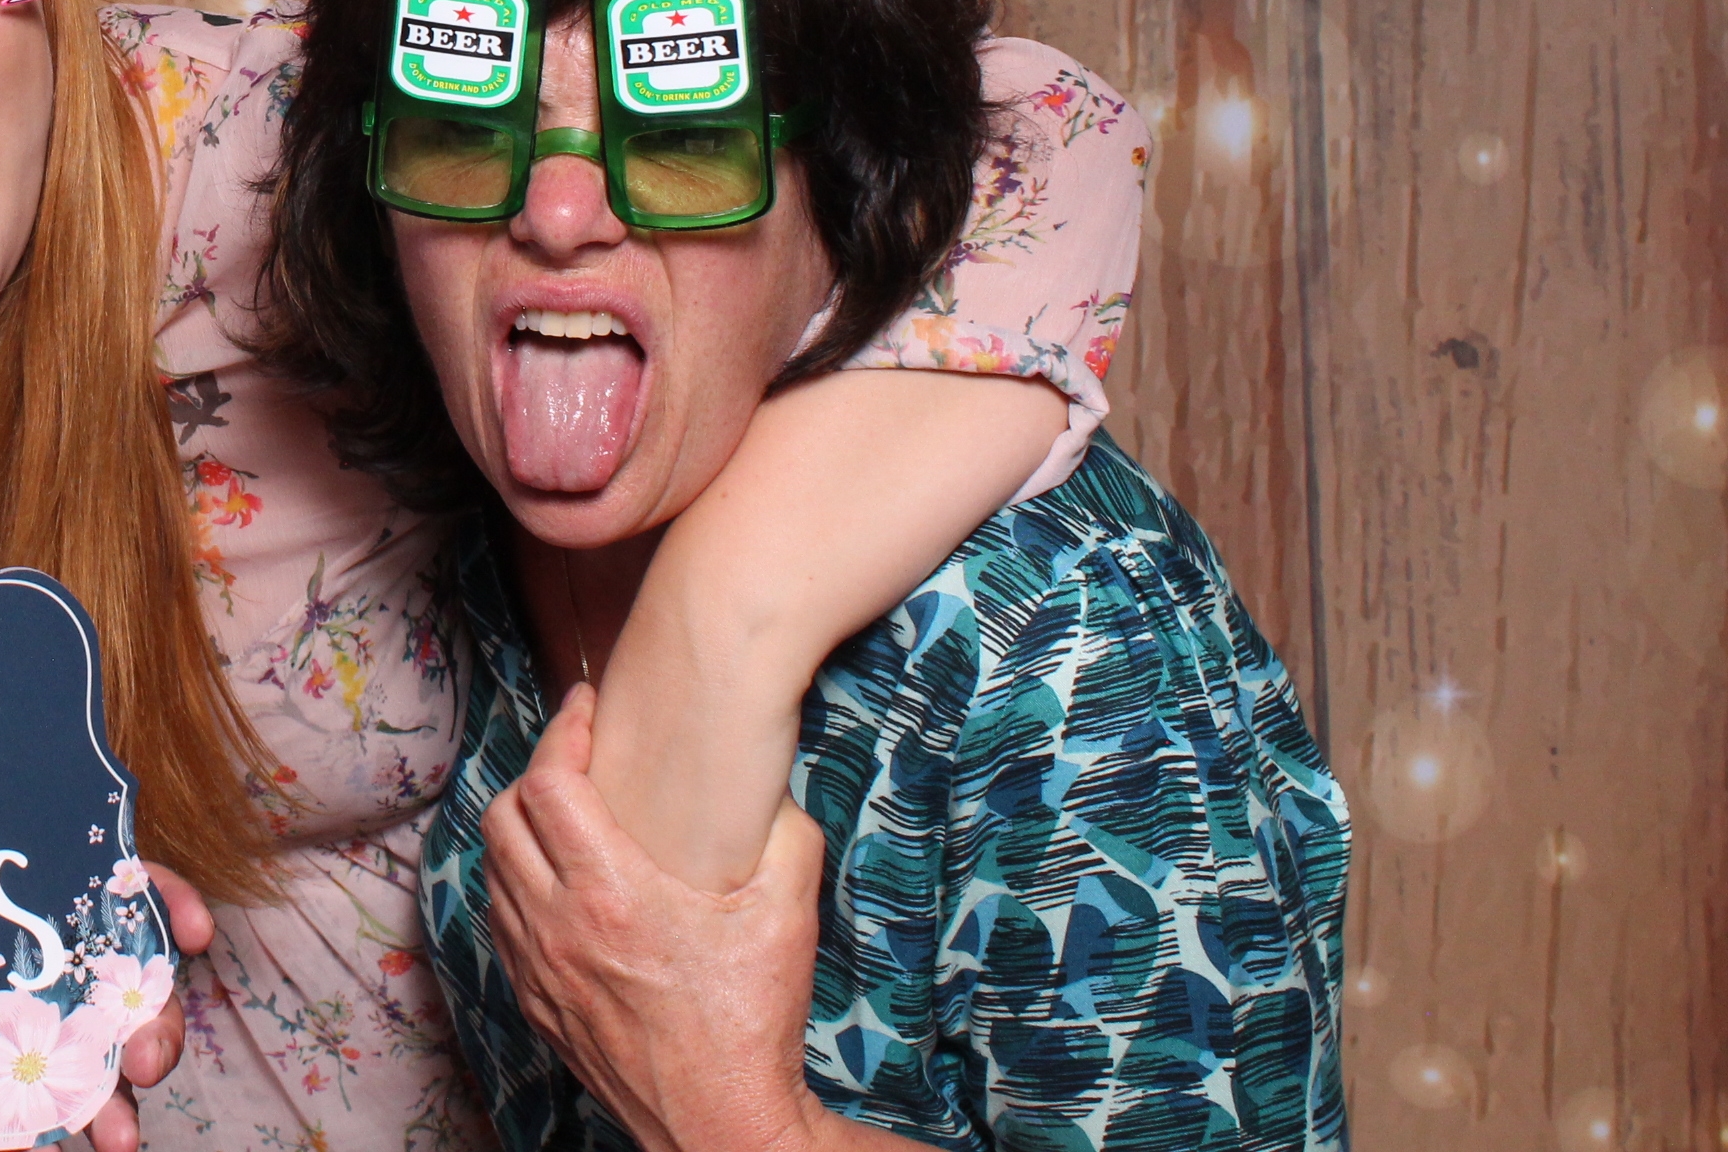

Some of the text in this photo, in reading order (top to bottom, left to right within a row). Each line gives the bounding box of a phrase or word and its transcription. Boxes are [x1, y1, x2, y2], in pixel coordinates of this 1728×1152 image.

[630, 1, 673, 22] GOLD
[406, 23, 504, 57] BEER
[627, 35, 731, 64] BEER
[409, 62, 506, 94] DON'T DRINK AND DRIVE
[634, 71, 735, 101] DON'T DRINK AND DRIVE
